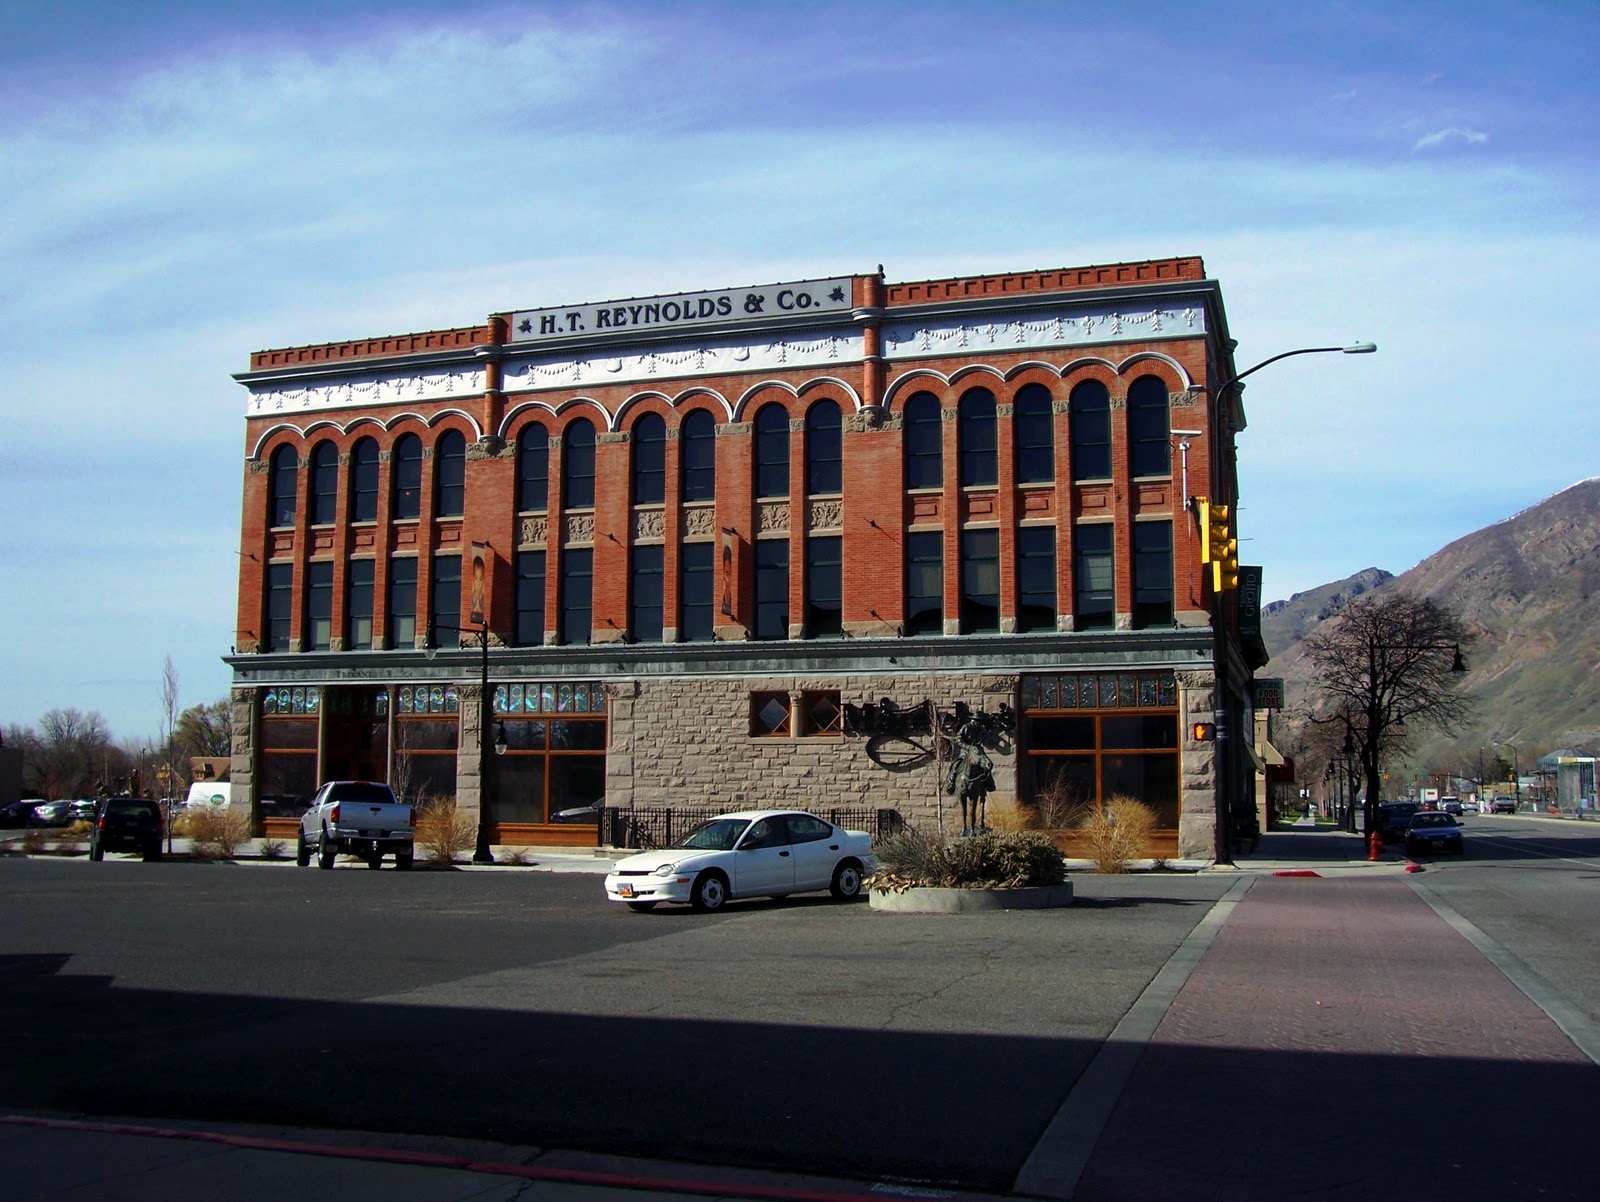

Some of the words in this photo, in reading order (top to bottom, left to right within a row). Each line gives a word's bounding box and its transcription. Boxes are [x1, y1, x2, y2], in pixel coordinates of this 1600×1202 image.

[595, 295, 733, 329] REYNOLDS
[743, 292, 765, 313] &
[776, 288, 821, 310] Co.
[1255, 681, 1281, 689] NATURAL
[1259, 689, 1278, 697] FOOD
[1257, 697, 1281, 706] STORE
